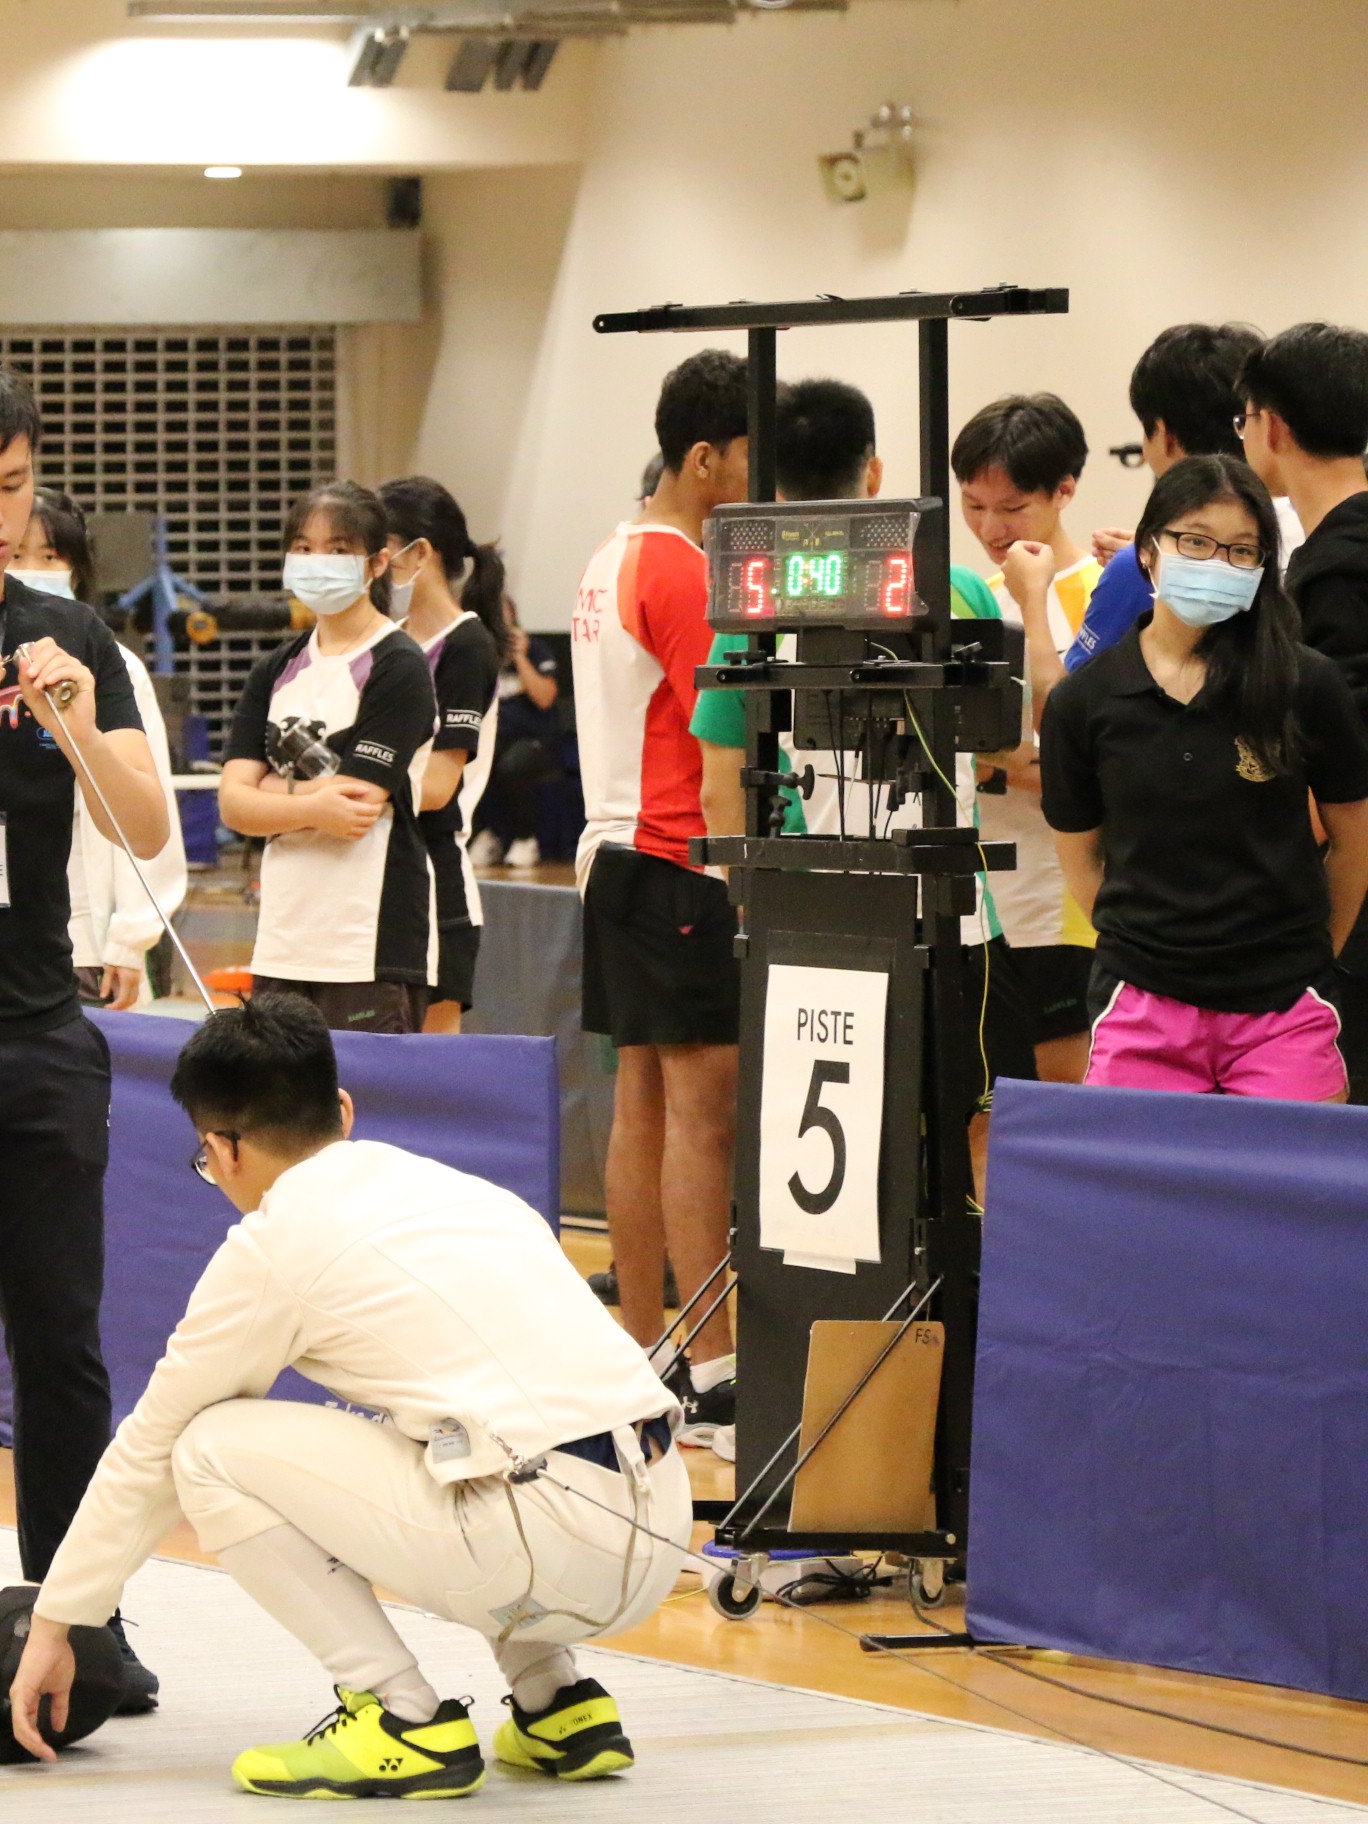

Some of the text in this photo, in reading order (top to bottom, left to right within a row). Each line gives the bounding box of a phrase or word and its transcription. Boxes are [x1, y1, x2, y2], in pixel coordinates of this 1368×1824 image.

[786, 554, 842, 597] 0:40
[885, 558, 907, 612] 2
[355, 742, 394, 763] RAFFLES
[797, 1007, 855, 1046] PISTE
[787, 1059, 850, 1215] 5
